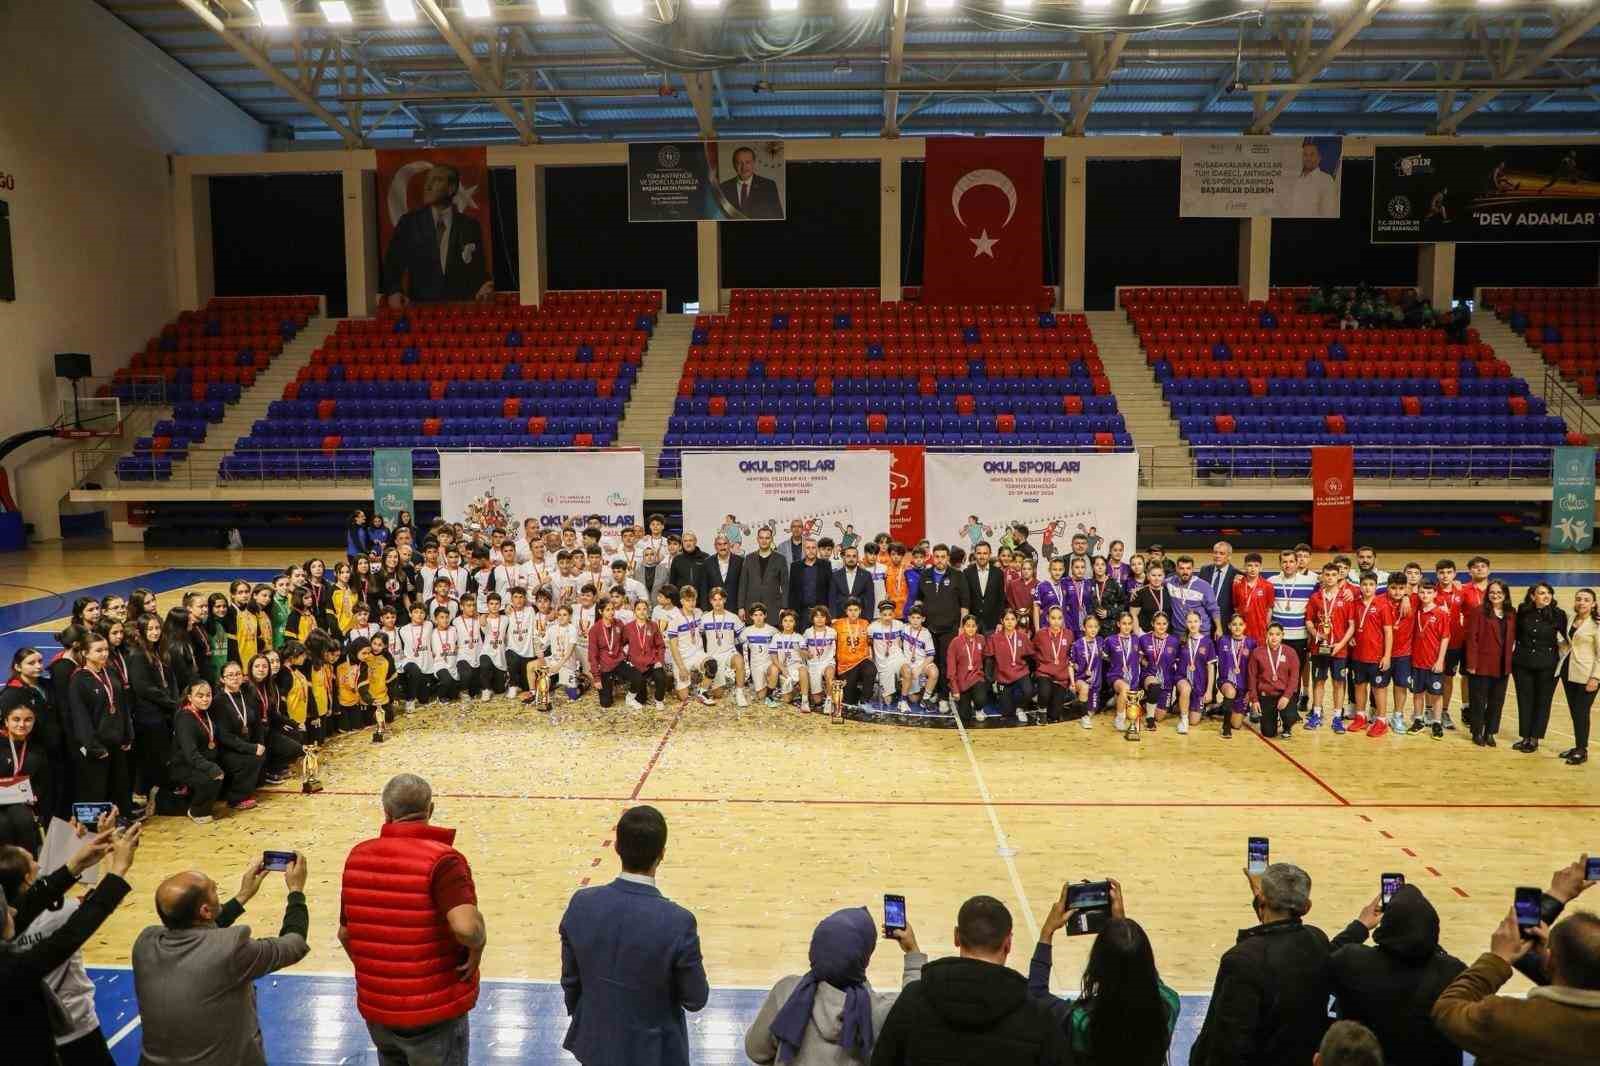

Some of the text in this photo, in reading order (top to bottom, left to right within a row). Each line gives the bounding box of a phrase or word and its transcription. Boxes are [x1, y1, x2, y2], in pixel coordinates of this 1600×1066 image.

[1516, 212, 1595, 226] ADAMLAR
[739, 458, 835, 473] OKUL SPORLARI
[983, 460, 1081, 474] OKUL SPORLARI
